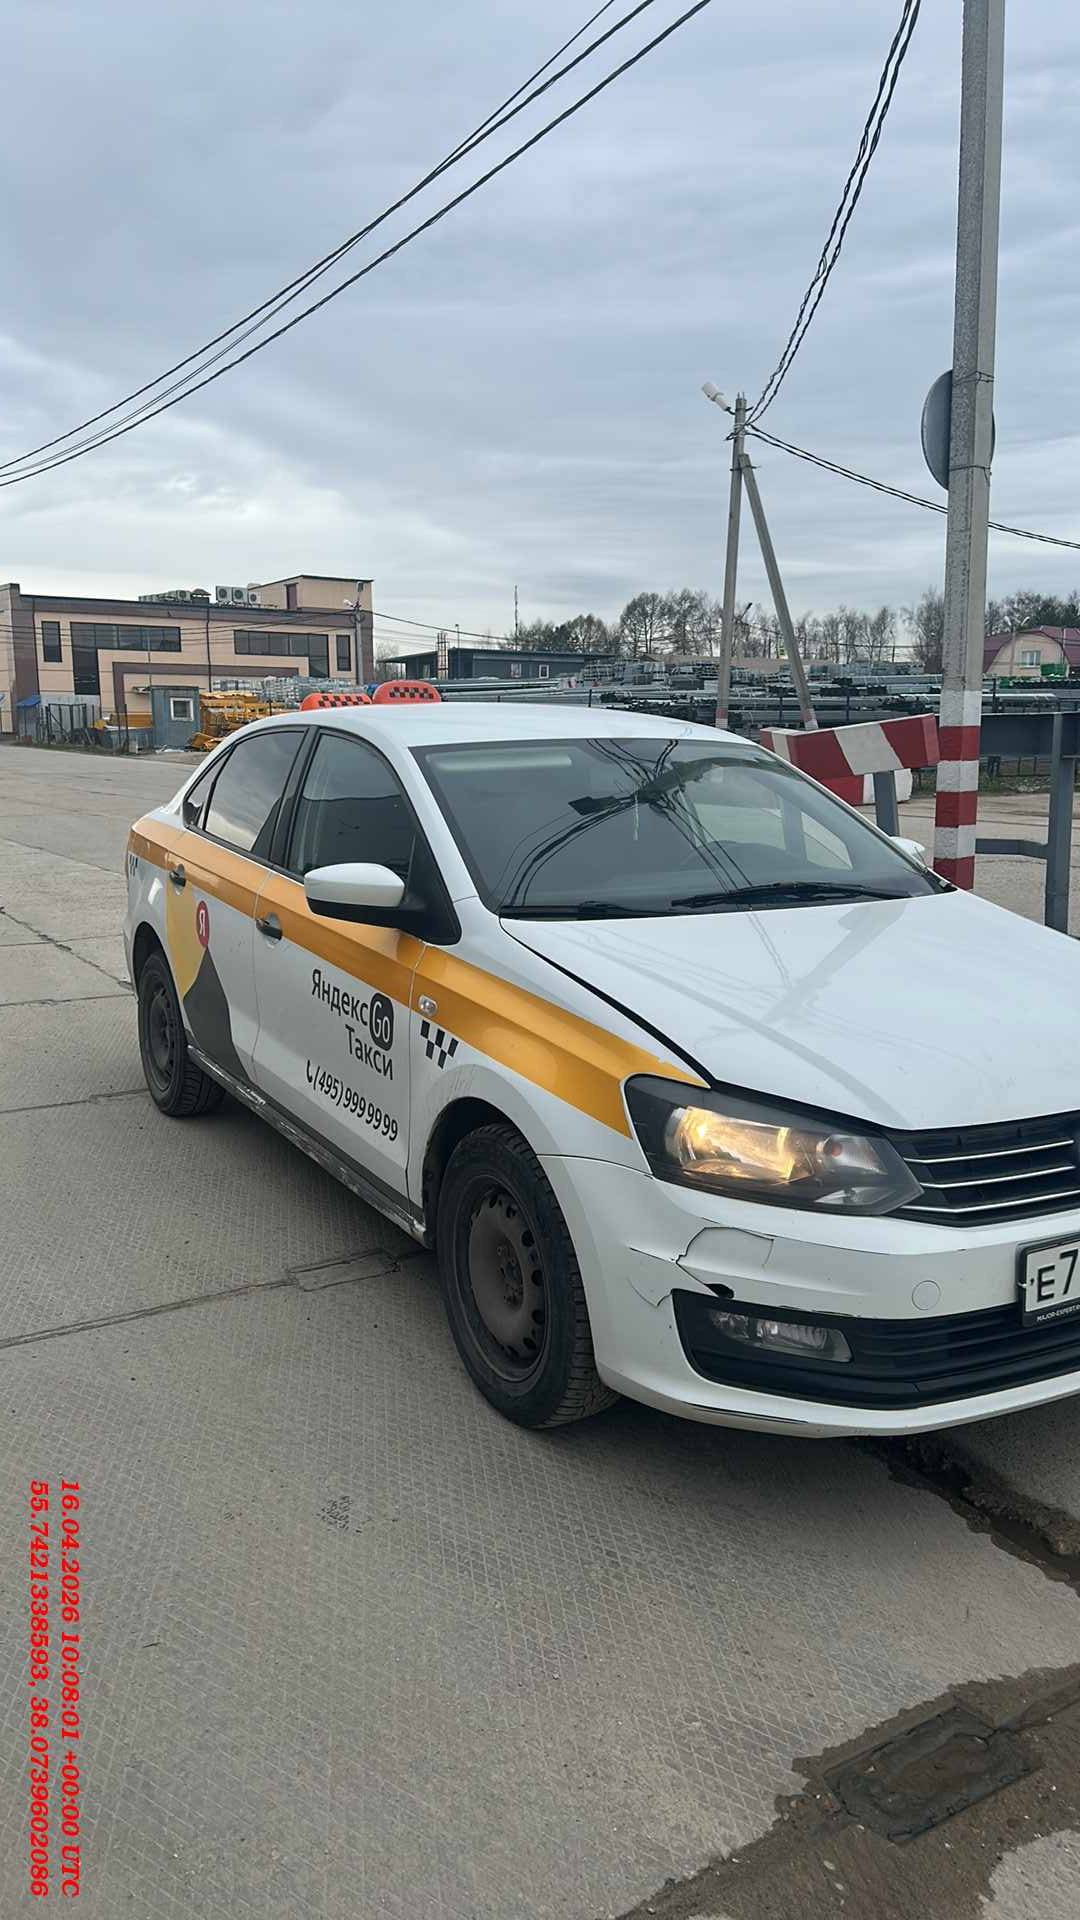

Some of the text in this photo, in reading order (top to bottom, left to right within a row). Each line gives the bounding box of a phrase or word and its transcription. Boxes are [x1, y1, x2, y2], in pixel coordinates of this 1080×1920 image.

[312, 969, 391, 1043] Яндекс Go
[345, 1024, 393, 1081] Такси
